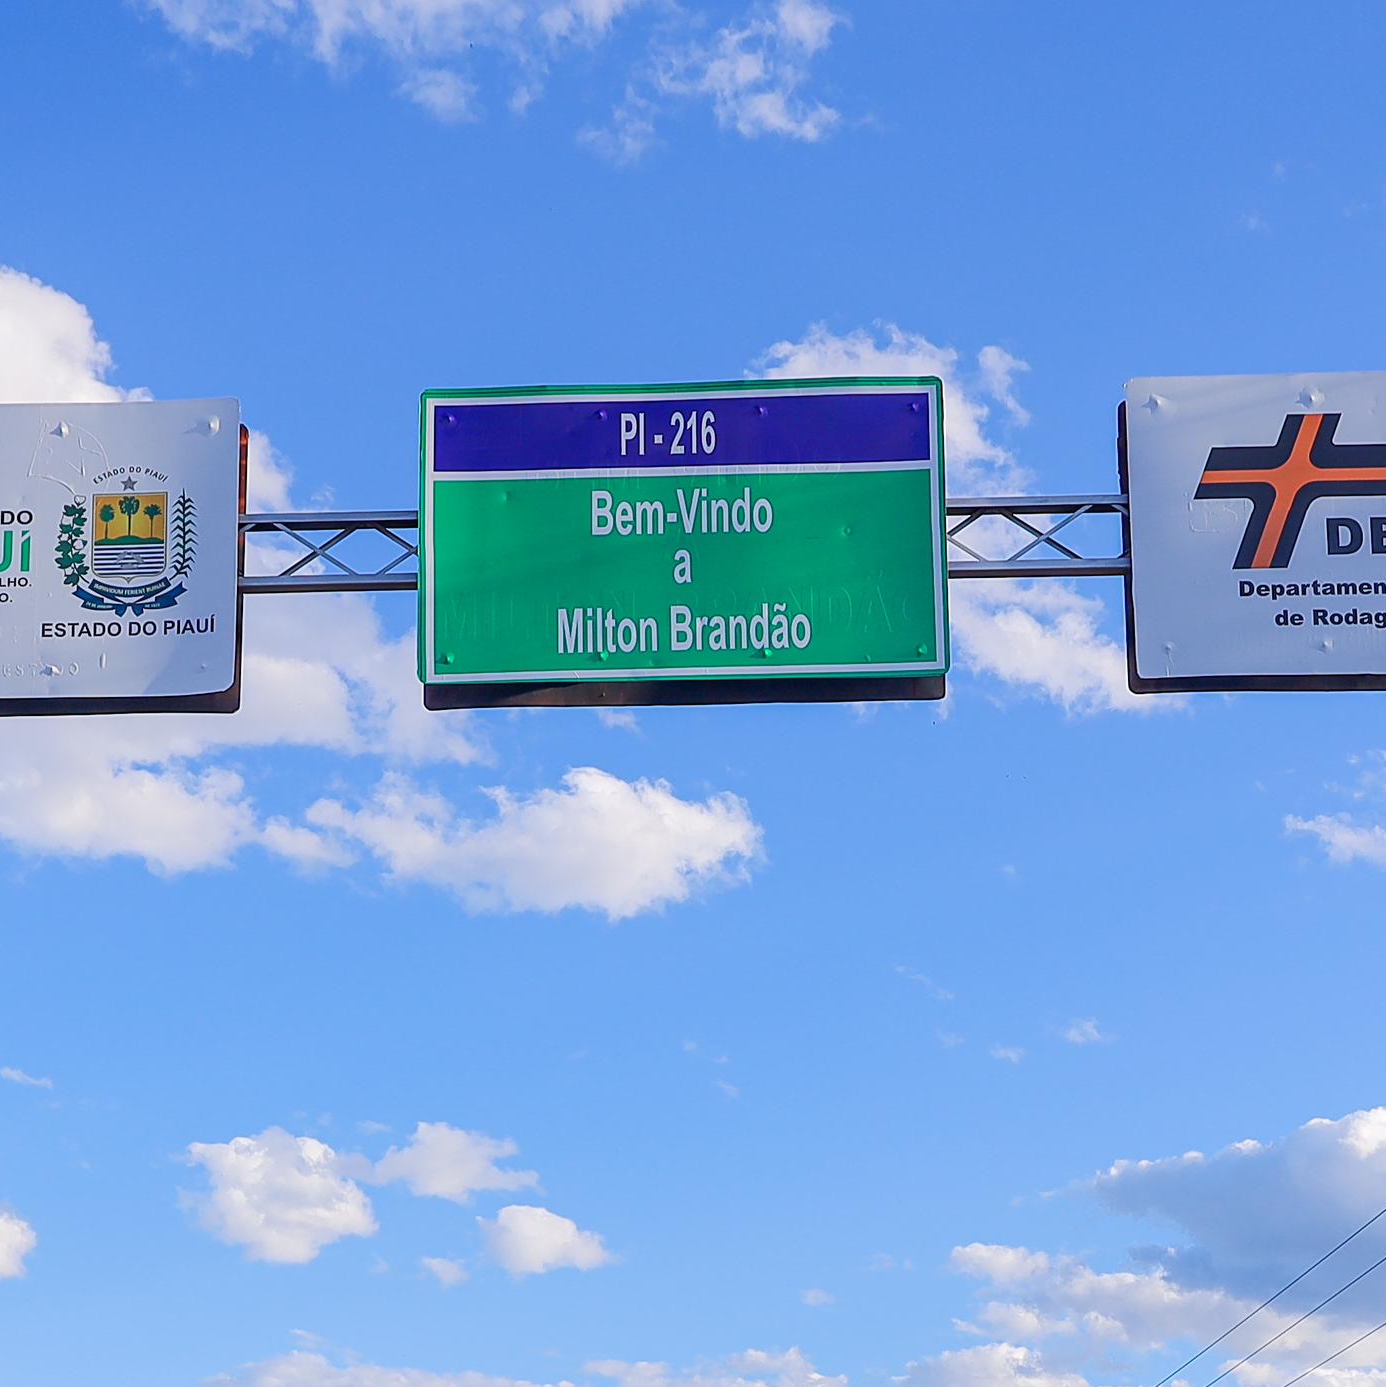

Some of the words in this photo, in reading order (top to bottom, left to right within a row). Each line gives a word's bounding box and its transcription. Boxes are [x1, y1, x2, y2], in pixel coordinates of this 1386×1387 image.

[620, 412, 645, 456] PI
[653, 433, 663, 444] -
[669, 410, 716, 455] 216
[93, 467, 125, 485] ESTADO
[129, 466, 142, 474] DO
[144, 468, 168, 483] PIAUÍ
[0, 509, 33, 527] DO
[591, 487, 773, 537] Bem-Vindo
[672, 548, 693, 584] a
[40, 621, 121, 639] ESTADO
[128, 620, 157, 636] DO
[163, 613, 216, 635] PIAUÍ
[557, 605, 658, 655] Milton
[669, 602, 812, 651] Brandão
[1274, 608, 1304, 627] de
